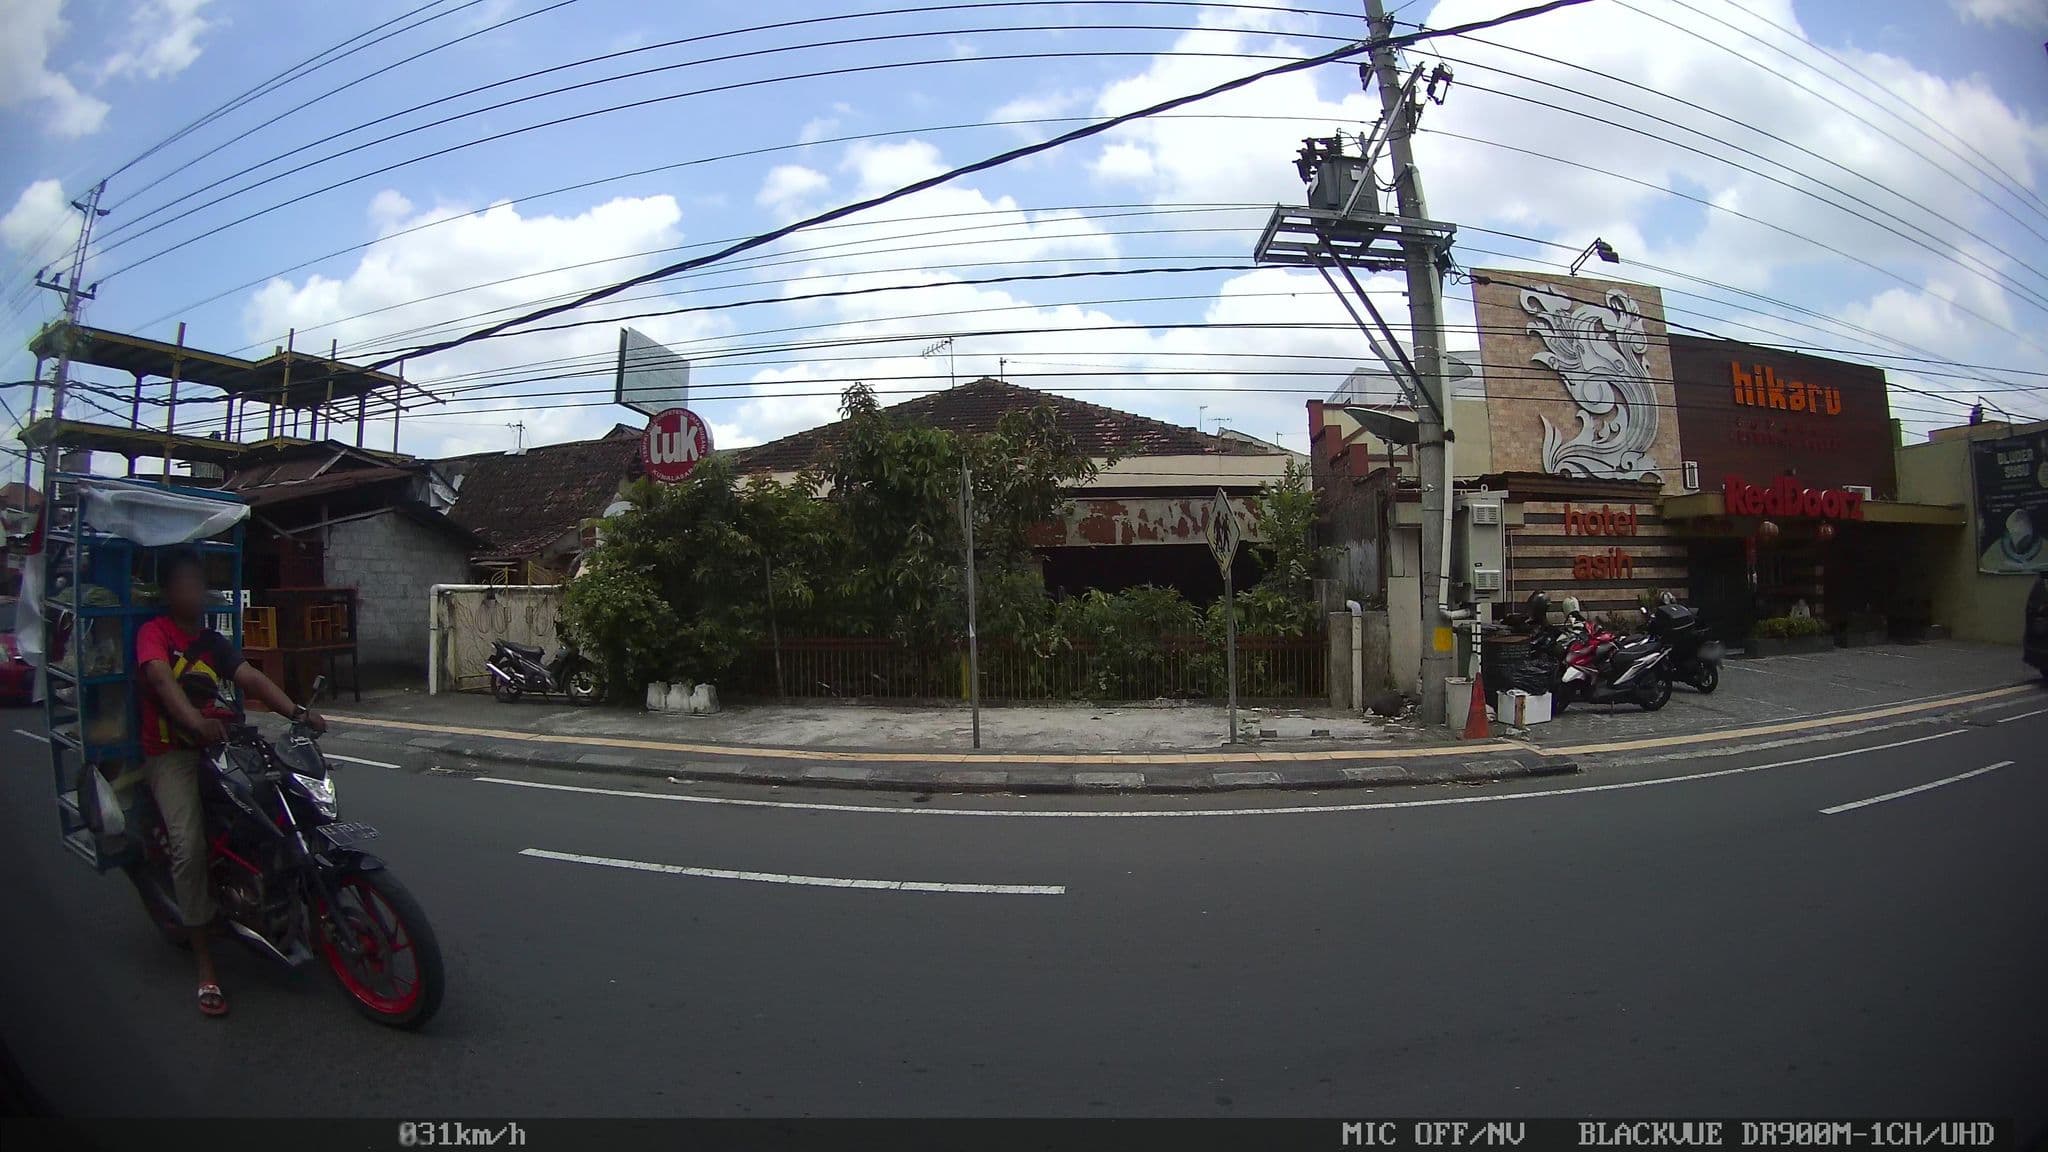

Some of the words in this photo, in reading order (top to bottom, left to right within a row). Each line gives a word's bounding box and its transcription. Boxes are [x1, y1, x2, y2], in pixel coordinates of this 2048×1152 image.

[1731, 361, 1841, 415] hikaru
[650, 415, 699, 464] tuk
[1564, 504, 1637, 536] hotel
[1724, 475, 1865, 520] RedDoorz
[1573, 548, 1633, 579] asih
